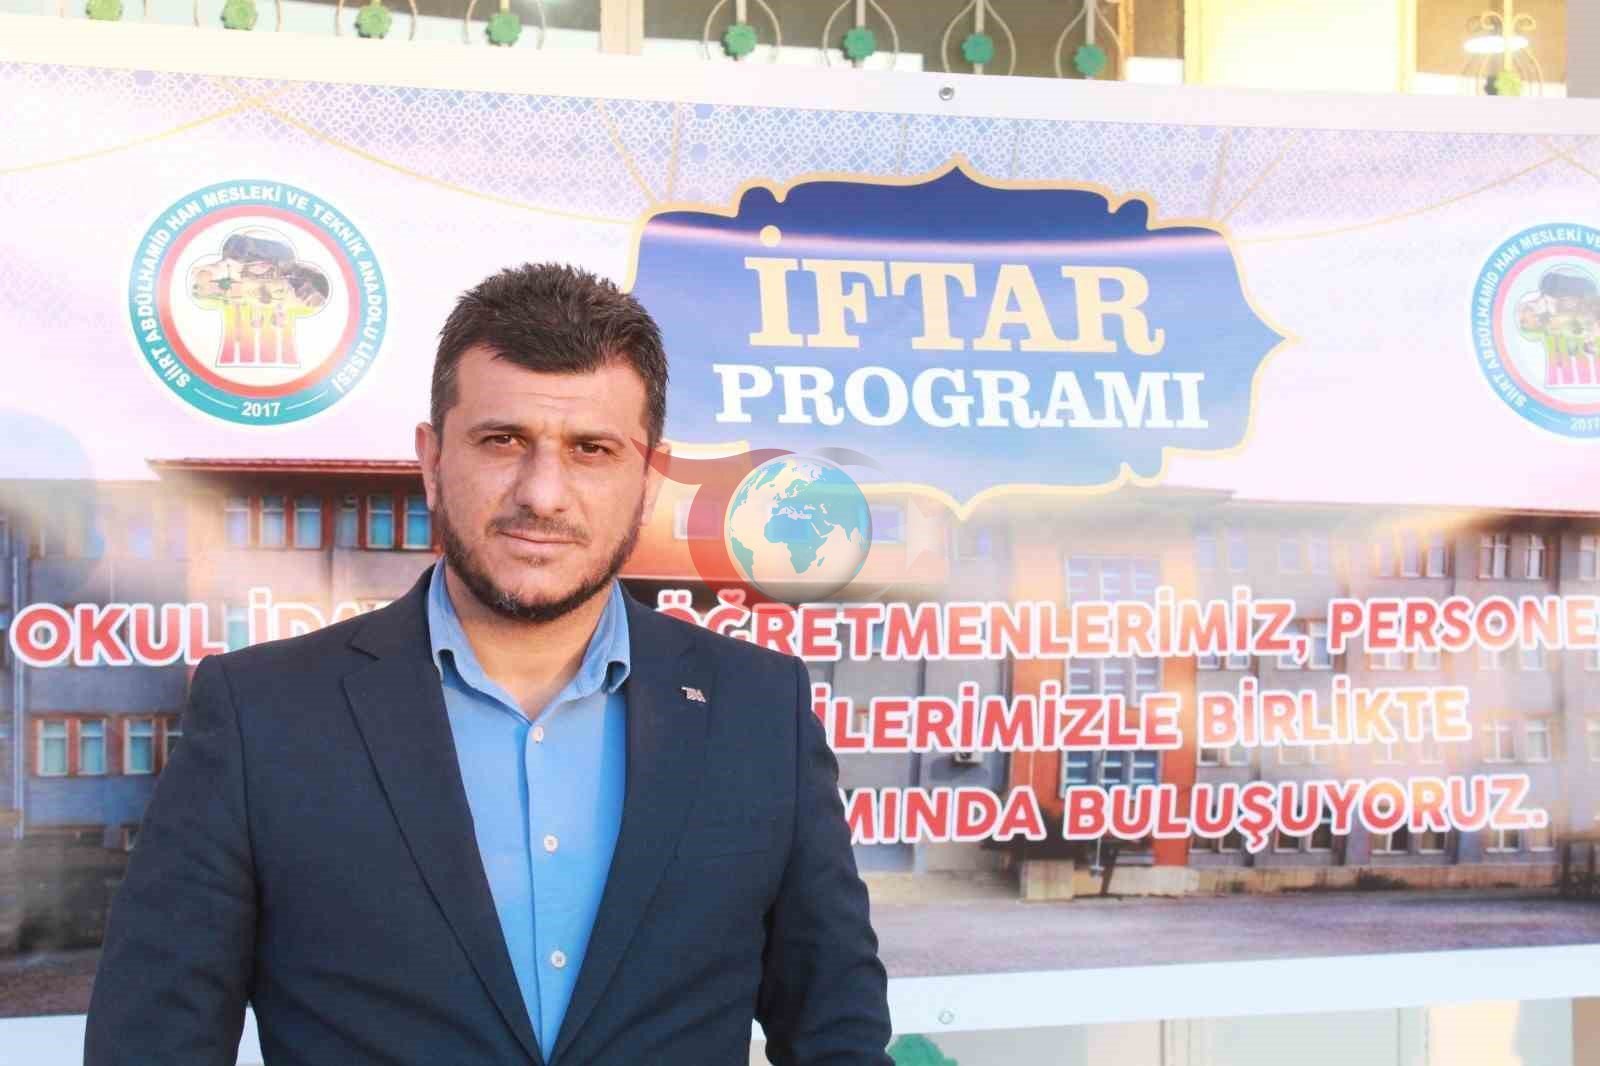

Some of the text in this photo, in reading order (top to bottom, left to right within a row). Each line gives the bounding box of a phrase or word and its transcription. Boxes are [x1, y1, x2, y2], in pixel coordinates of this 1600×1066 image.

[166, 201, 201, 229] HAN
[201, 184, 280, 208] MESLEKİ
[286, 190, 310, 210] VE
[311, 201, 363, 257] TEKNİK
[1494, 245, 1521, 272] HAN
[1520, 227, 1581, 249] MESLEKİ
[357, 258, 382, 340] ANADOLU
[744, 225, 1165, 356] İFTAR
[151, 346, 191, 388] SİİRT
[241, 402, 281, 417] 2017
[712, 363, 1208, 429] PROGRAMI
[10, 602, 229, 667] OKUL
[1326, 595, 1600, 655] PERSONE
[1198, 675, 1472, 749] BİRLİKTE
[1063, 773, 1550, 854] BULUŞUYORUZ.
